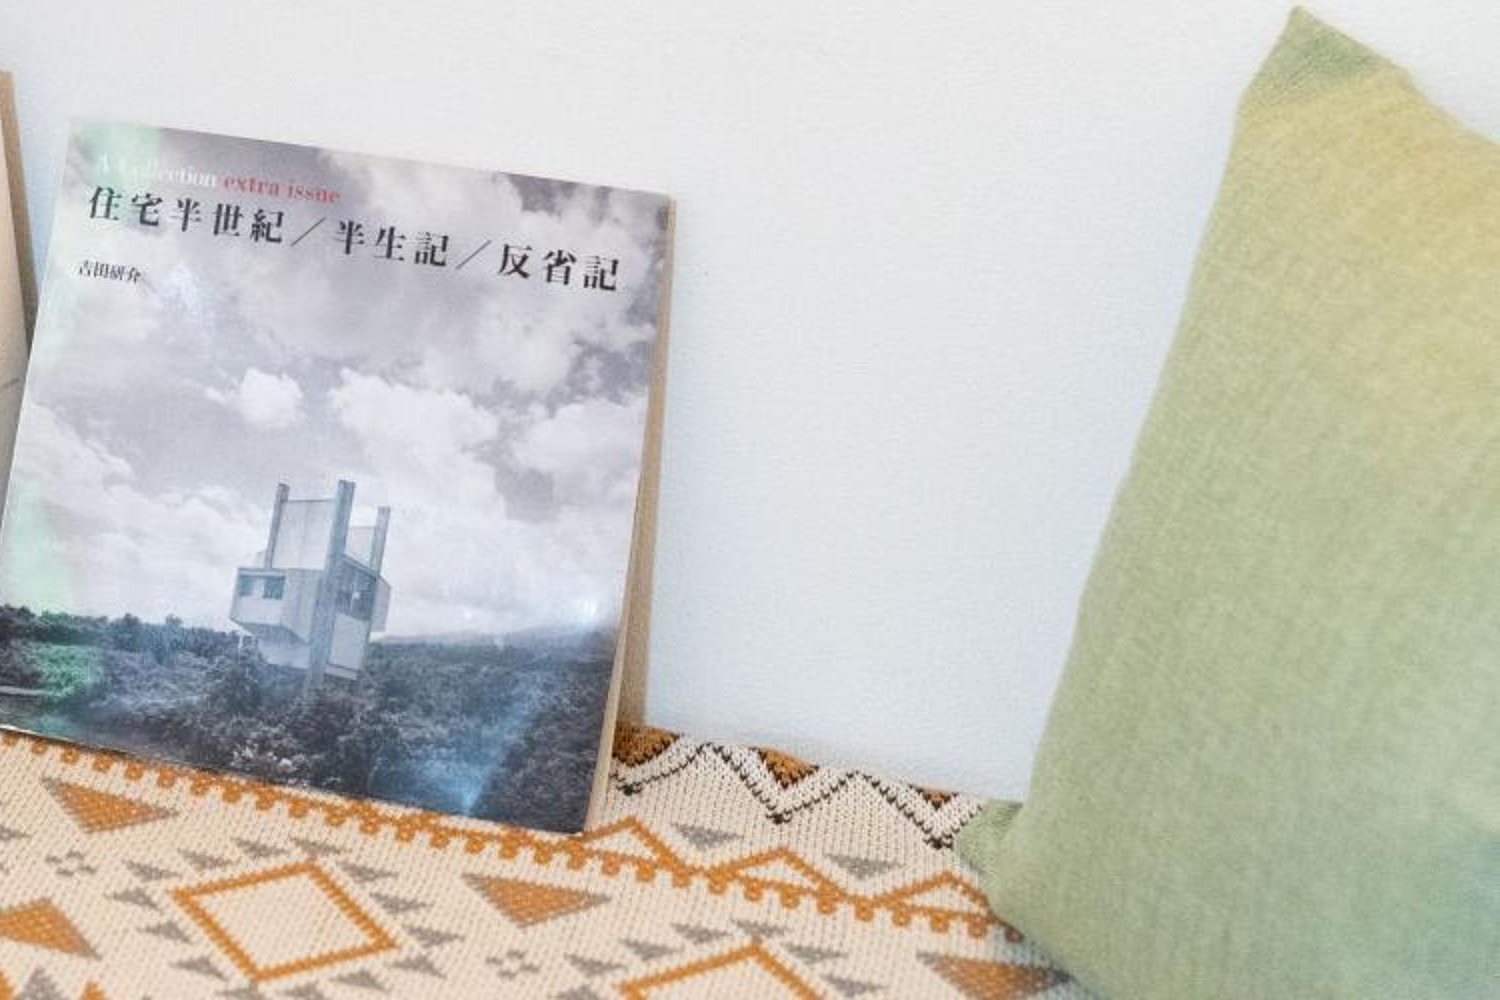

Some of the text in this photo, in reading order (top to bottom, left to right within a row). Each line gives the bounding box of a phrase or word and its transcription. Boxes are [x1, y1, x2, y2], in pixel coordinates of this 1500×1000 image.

[223, 175, 279, 197] extra
[289, 179, 341, 204] issue
[88, 186, 619, 291] 住宅半世紀／半生記／反省記
[79, 260, 142, 284] 吉田研介
